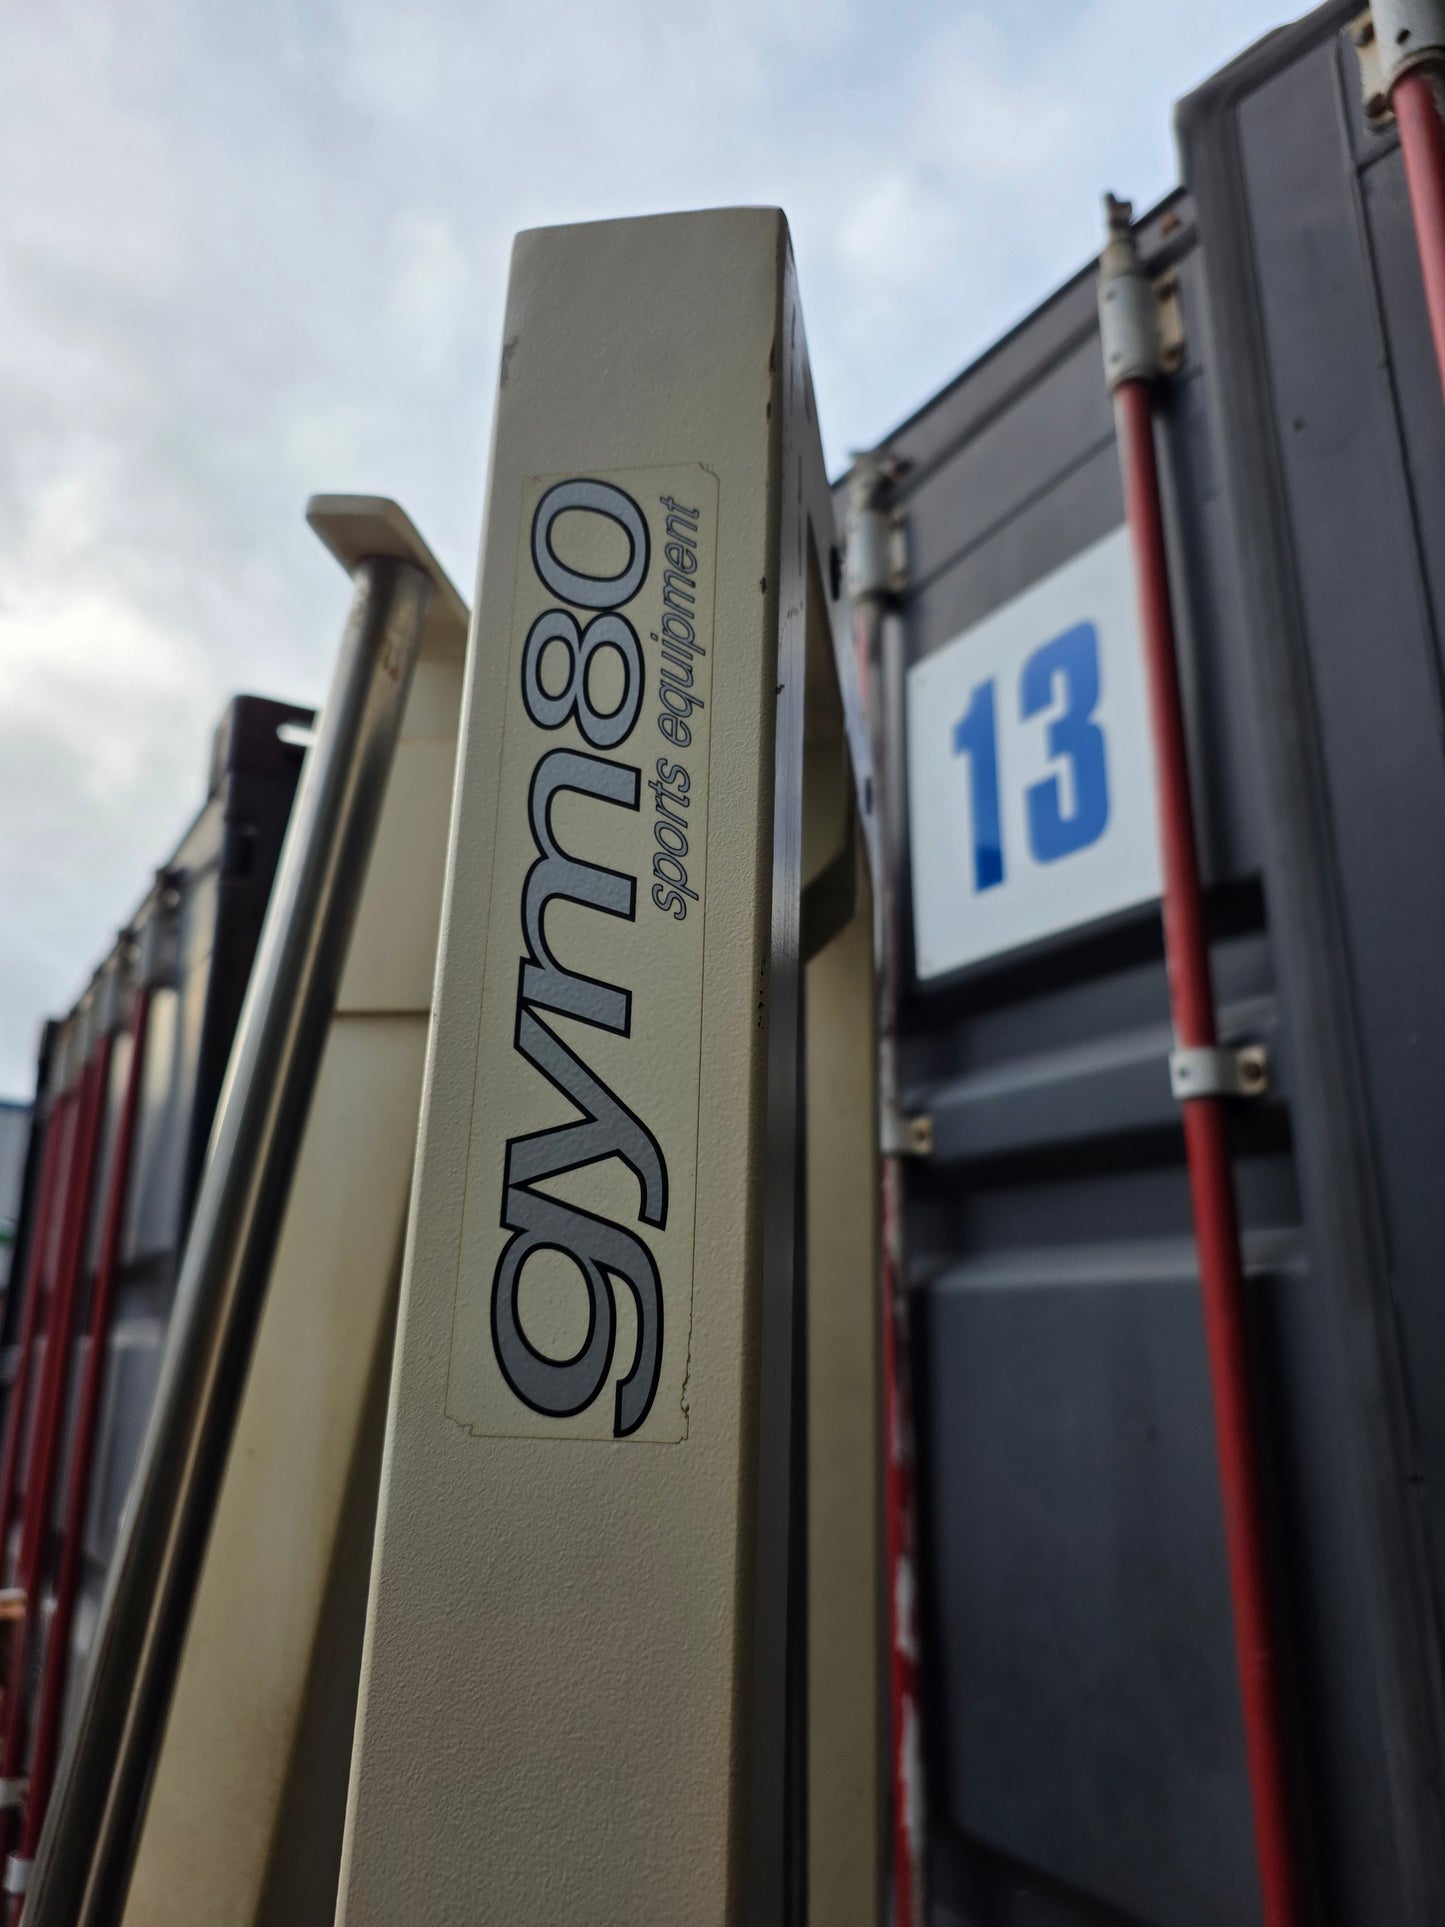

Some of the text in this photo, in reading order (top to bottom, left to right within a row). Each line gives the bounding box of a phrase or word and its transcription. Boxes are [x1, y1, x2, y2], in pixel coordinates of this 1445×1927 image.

[647, 495, 707, 921] sports equipment
[952, 616, 1110, 896] 13
[490, 478, 669, 1438] gym80
